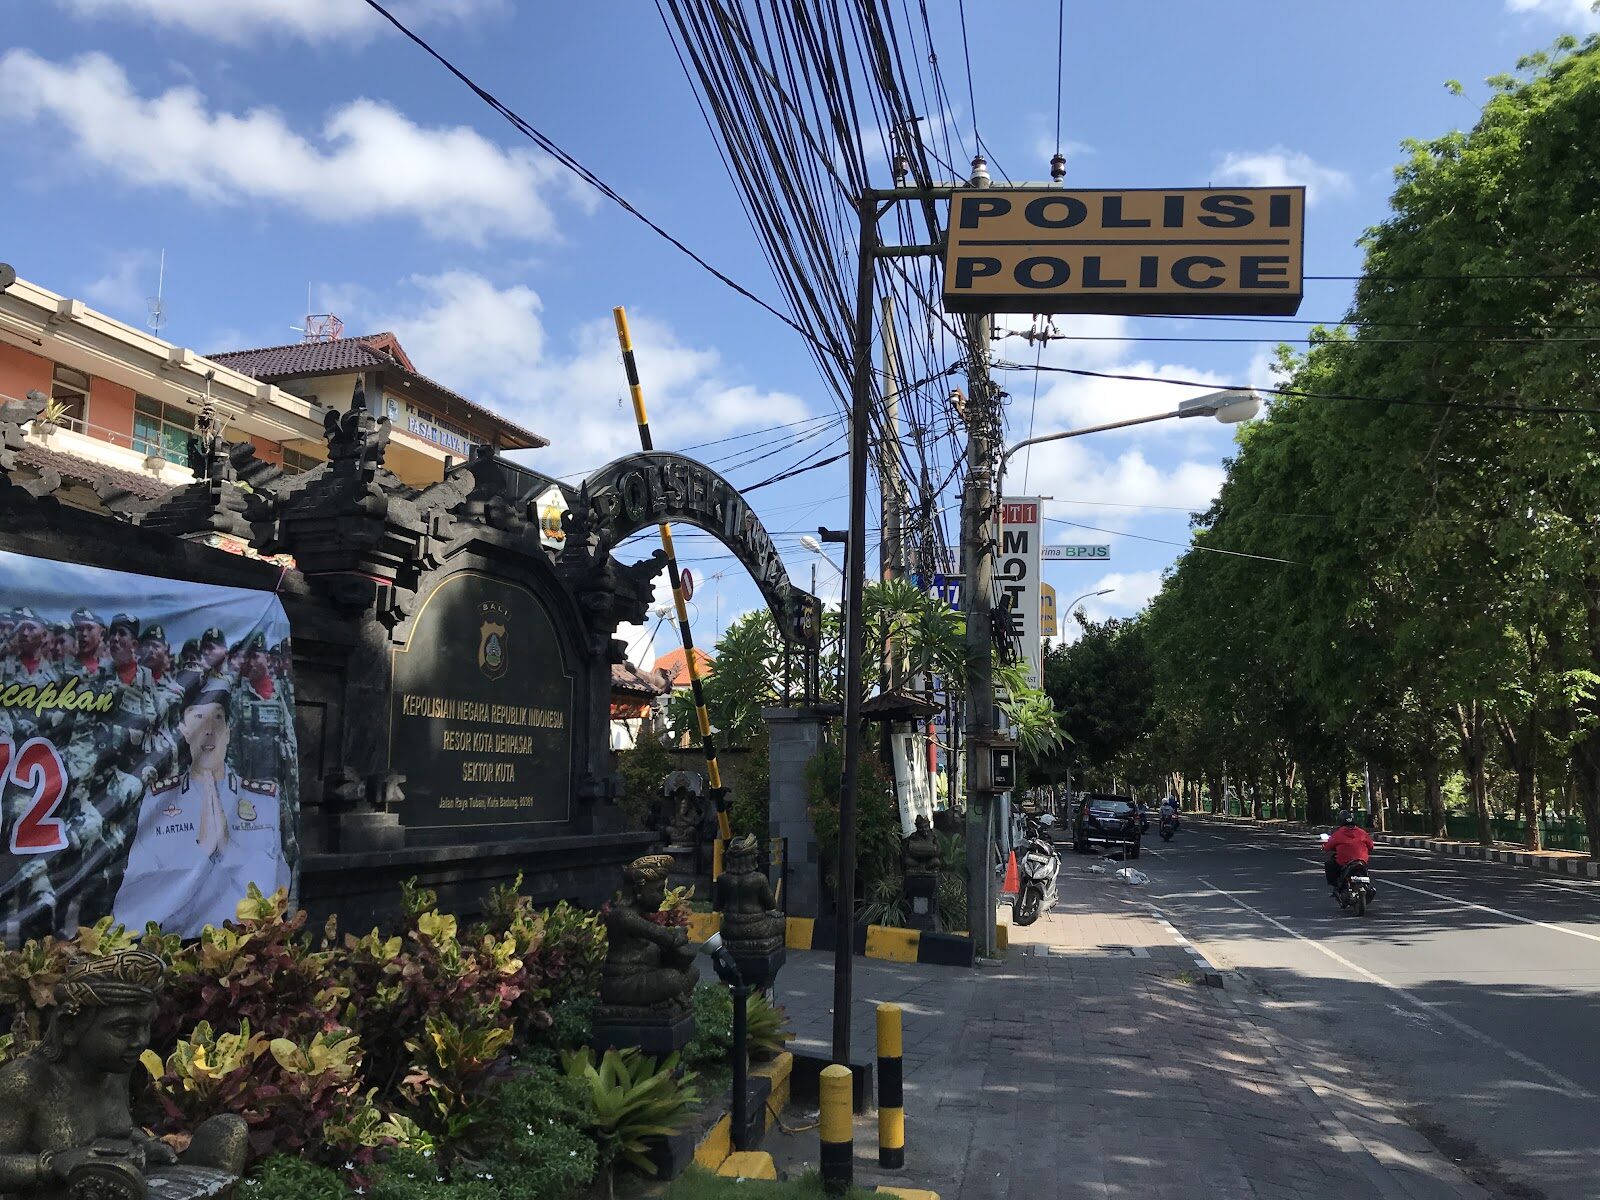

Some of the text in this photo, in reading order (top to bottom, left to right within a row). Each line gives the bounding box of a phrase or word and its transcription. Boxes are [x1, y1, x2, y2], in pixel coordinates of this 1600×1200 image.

[958, 193, 1292, 229] POLISI
[953, 254, 1292, 290] POLICE
[408, 417, 438, 443] PASAR
[1040, 546, 1107, 557] rima BPJS
[482, 603, 509, 616] BALI
[0, 676, 114, 718] capkan
[402, 694, 564, 729] KEPOLISIAN NEGARA REPUBLIK INDONESIA
[443, 730, 533, 755] RESOR KOTA DENPASAR
[462, 761, 515, 782] SEKTOR KUTA
[439, 796, 455, 809] Jalan
[455, 797, 469, 811] Raya
[487, 796, 499, 808] Kuta
